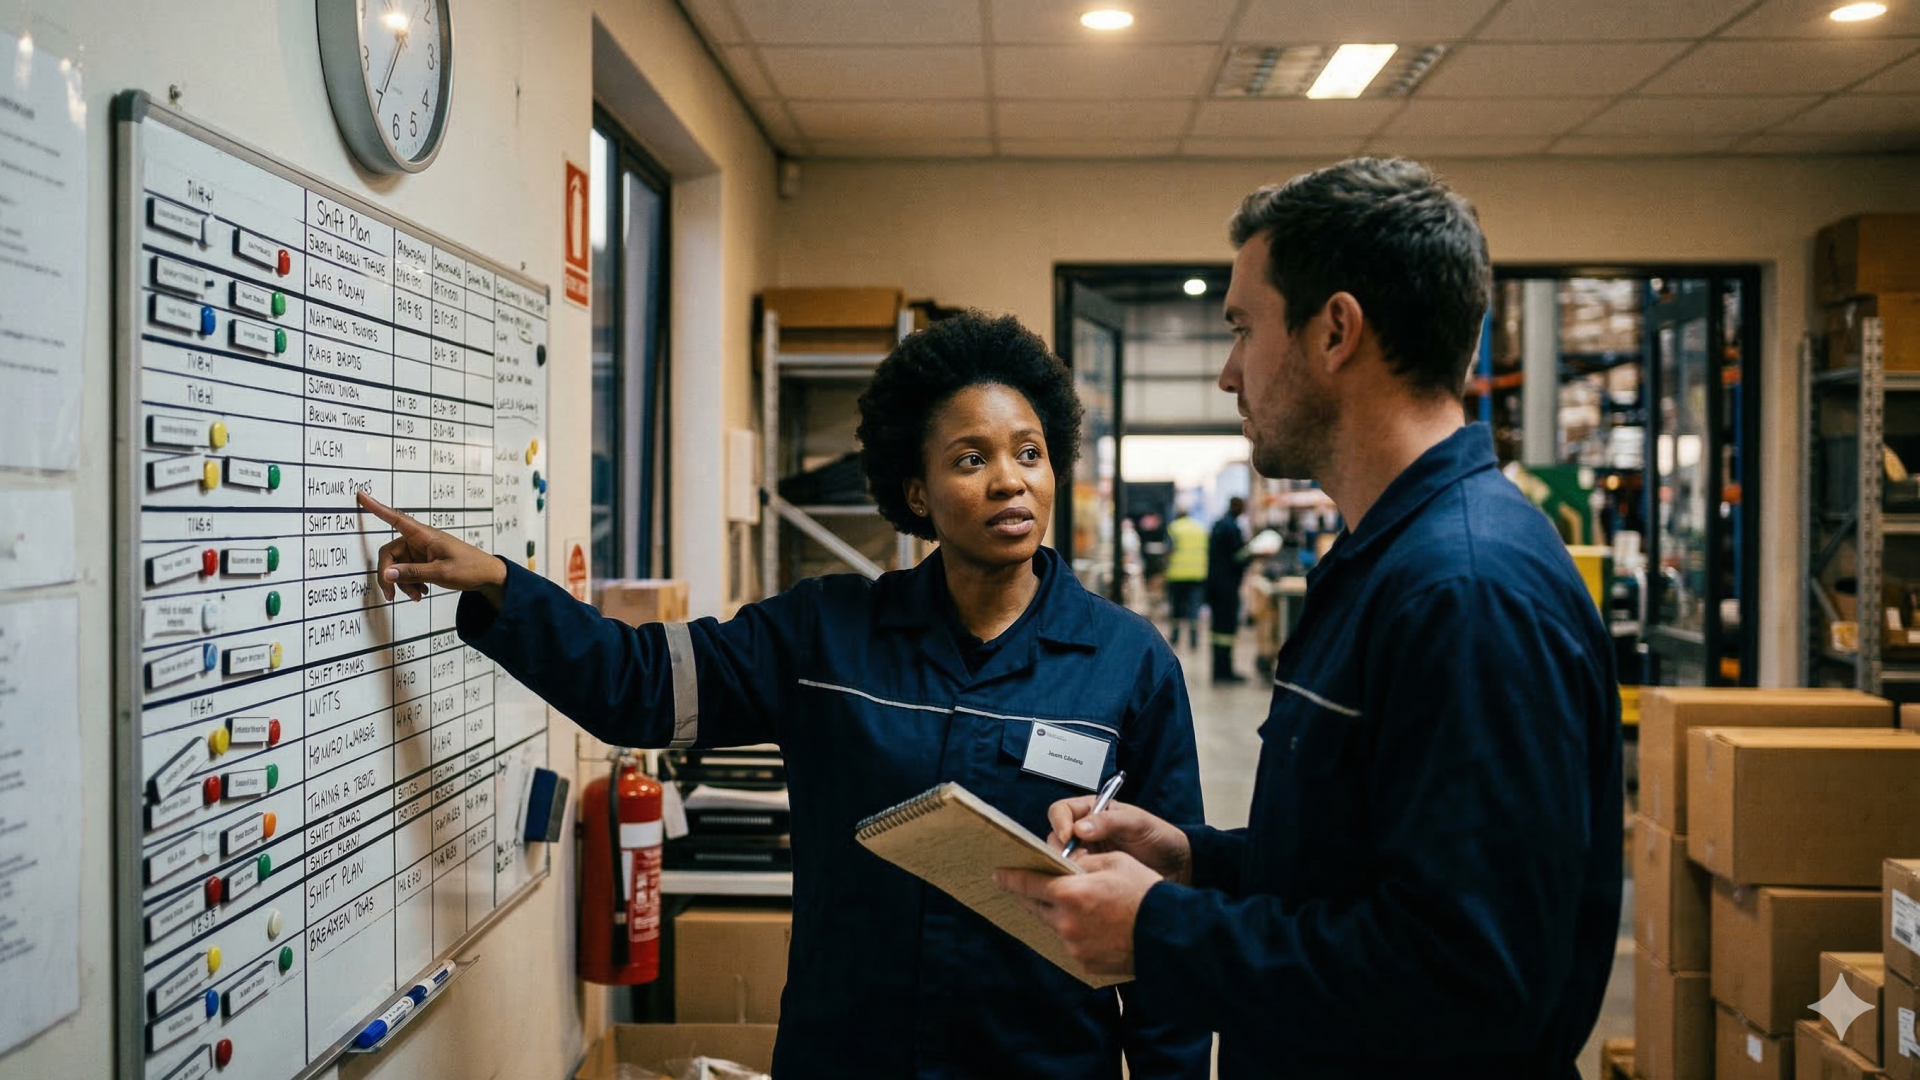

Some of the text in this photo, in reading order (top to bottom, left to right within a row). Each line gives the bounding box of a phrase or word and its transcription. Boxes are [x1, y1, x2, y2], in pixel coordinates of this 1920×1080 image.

[427, 43, 435, 70] 3
[375, 88, 384, 114] 7
[421, 88, 430, 112] 4
[392, 113, 401, 141] 6
[409, 111, 418, 137] 5
[317, 199, 371, 244] Shift Plan
[309, 437, 343, 459] LACEM
[308, 514, 355, 532] SHIFT PLAN
[340, 616, 361, 638] PLAN
[308, 666, 333, 687] SHIFT
[309, 821, 335, 845] SHIFT
[309, 848, 334, 871] SHIFT
[309, 856, 364, 909] SHIFT PLAN
